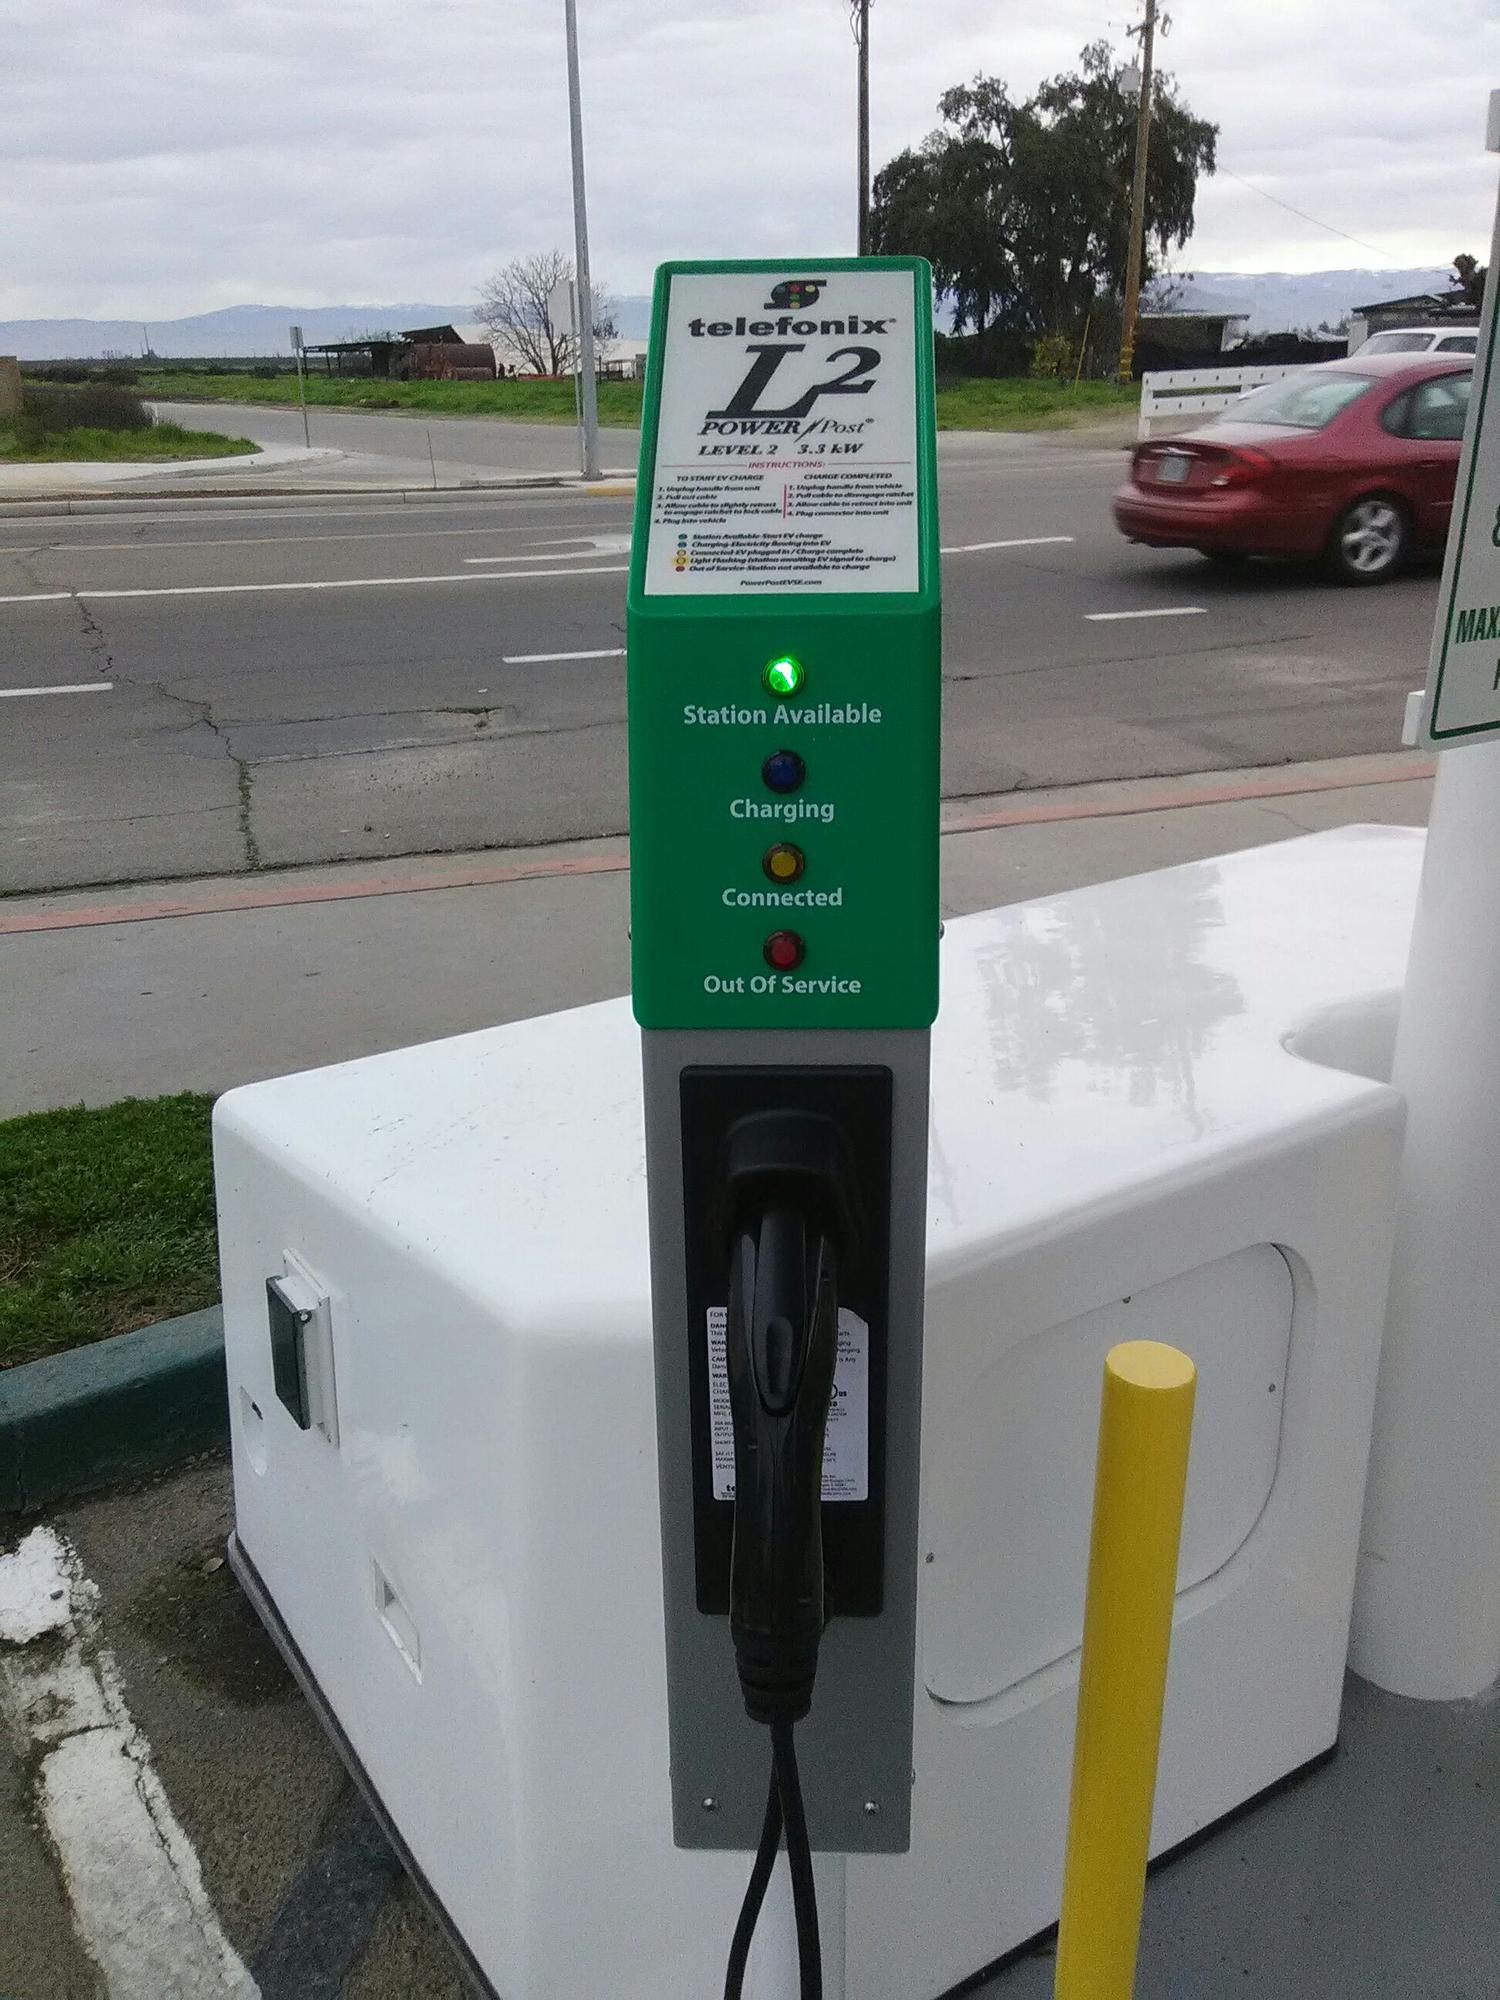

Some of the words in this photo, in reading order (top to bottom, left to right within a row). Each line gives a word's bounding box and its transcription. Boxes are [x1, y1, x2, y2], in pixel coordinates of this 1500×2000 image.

[689, 315, 889, 337] telefonix
[697, 420, 800, 436] POWER
[698, 445, 762, 456] LEVEL
[766, 444, 779, 455] 2
[797, 443, 826, 455] 3.3
[830, 443, 864, 454] kW
[748, 461, 826, 469] INSTRUCTIONS:
[683, 703, 766, 725] Station
[773, 703, 882, 725] Available
[729, 798, 835, 823] Charging
[722, 887, 843, 907] Connected
[703, 975, 745, 994] Out
[750, 975, 777, 994] Of
[781, 976, 862, 994] Service
